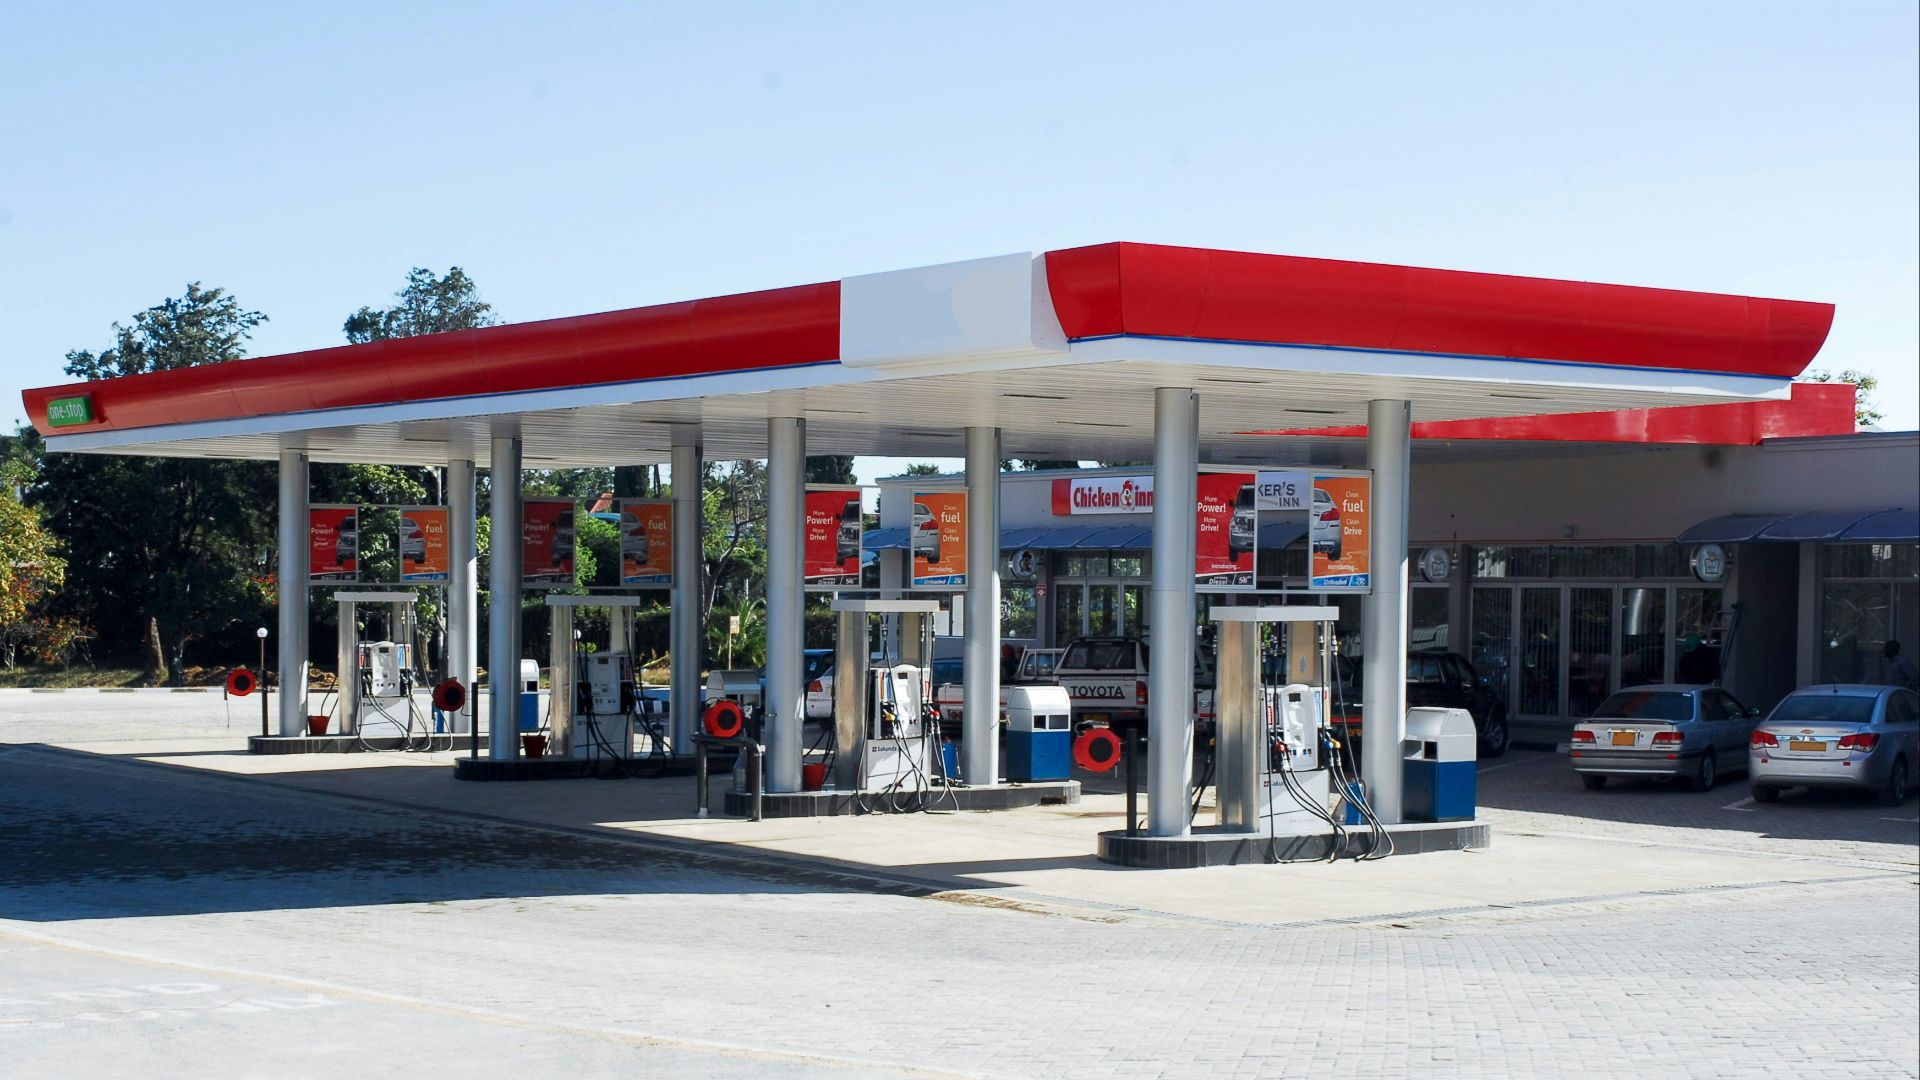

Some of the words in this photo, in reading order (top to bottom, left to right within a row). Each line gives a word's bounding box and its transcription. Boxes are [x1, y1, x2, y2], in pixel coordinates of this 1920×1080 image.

[49, 401, 84, 421] one-stop
[1073, 486, 1120, 508] Chicken
[1134, 485, 1154, 507] inn
[1345, 490, 1360, 498] Clean
[1278, 496, 1300, 507] INN
[1342, 499, 1364, 513] fuel
[1197, 502, 1226, 513] Power!
[806, 515, 833, 525] Power!
[940, 511, 961, 523] fuel
[425, 524, 443, 533] fuel
[648, 519, 666, 530] fuel
[1200, 523, 1219, 532] Drive!
[1343, 526, 1362, 536] Drive
[809, 533, 827, 541] Drive!
[942, 534, 960, 543] Drive
[1070, 686, 1125, 697] TOYOTA
